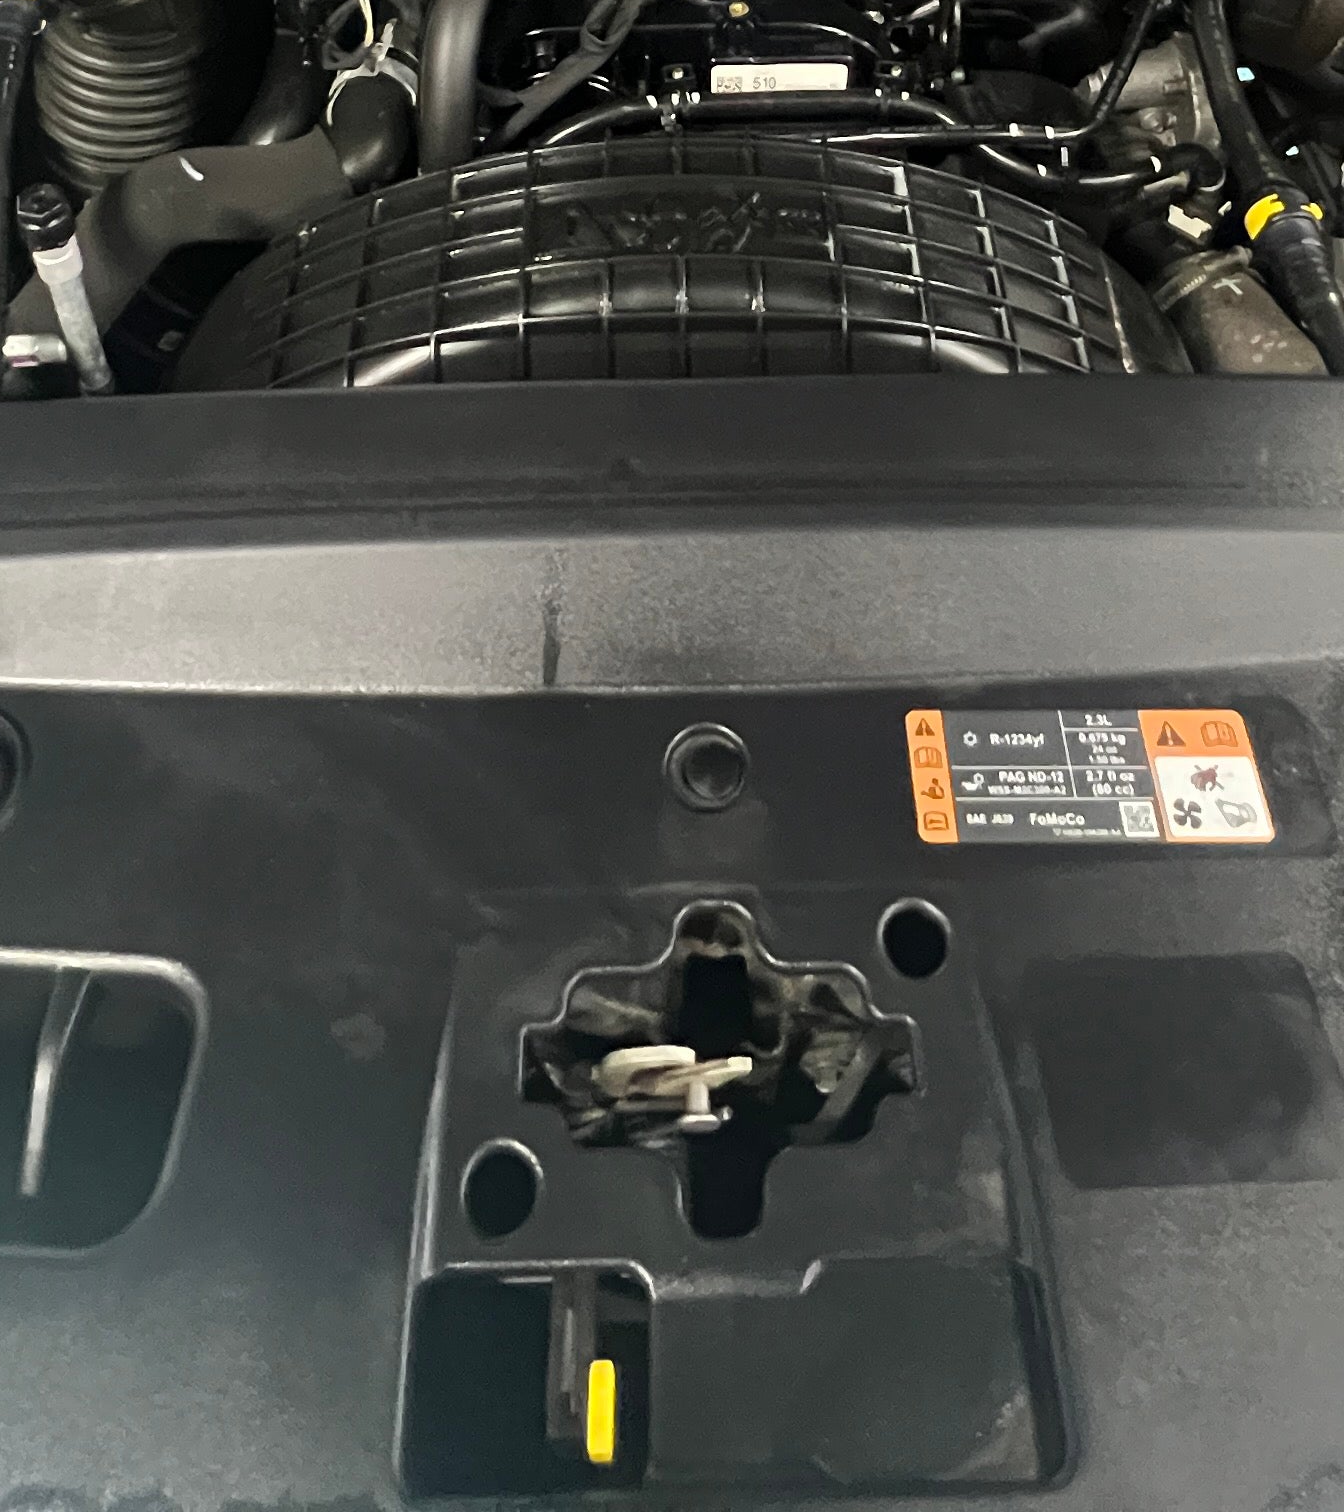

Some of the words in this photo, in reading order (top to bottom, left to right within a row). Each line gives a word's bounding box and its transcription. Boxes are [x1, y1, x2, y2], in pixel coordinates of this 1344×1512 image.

[752, 76, 777, 90] 510
[998, 771, 1026, 783] PAG
[1027, 771, 1065, 783] ND-12
[1029, 812, 1086, 826] FoMoCo
